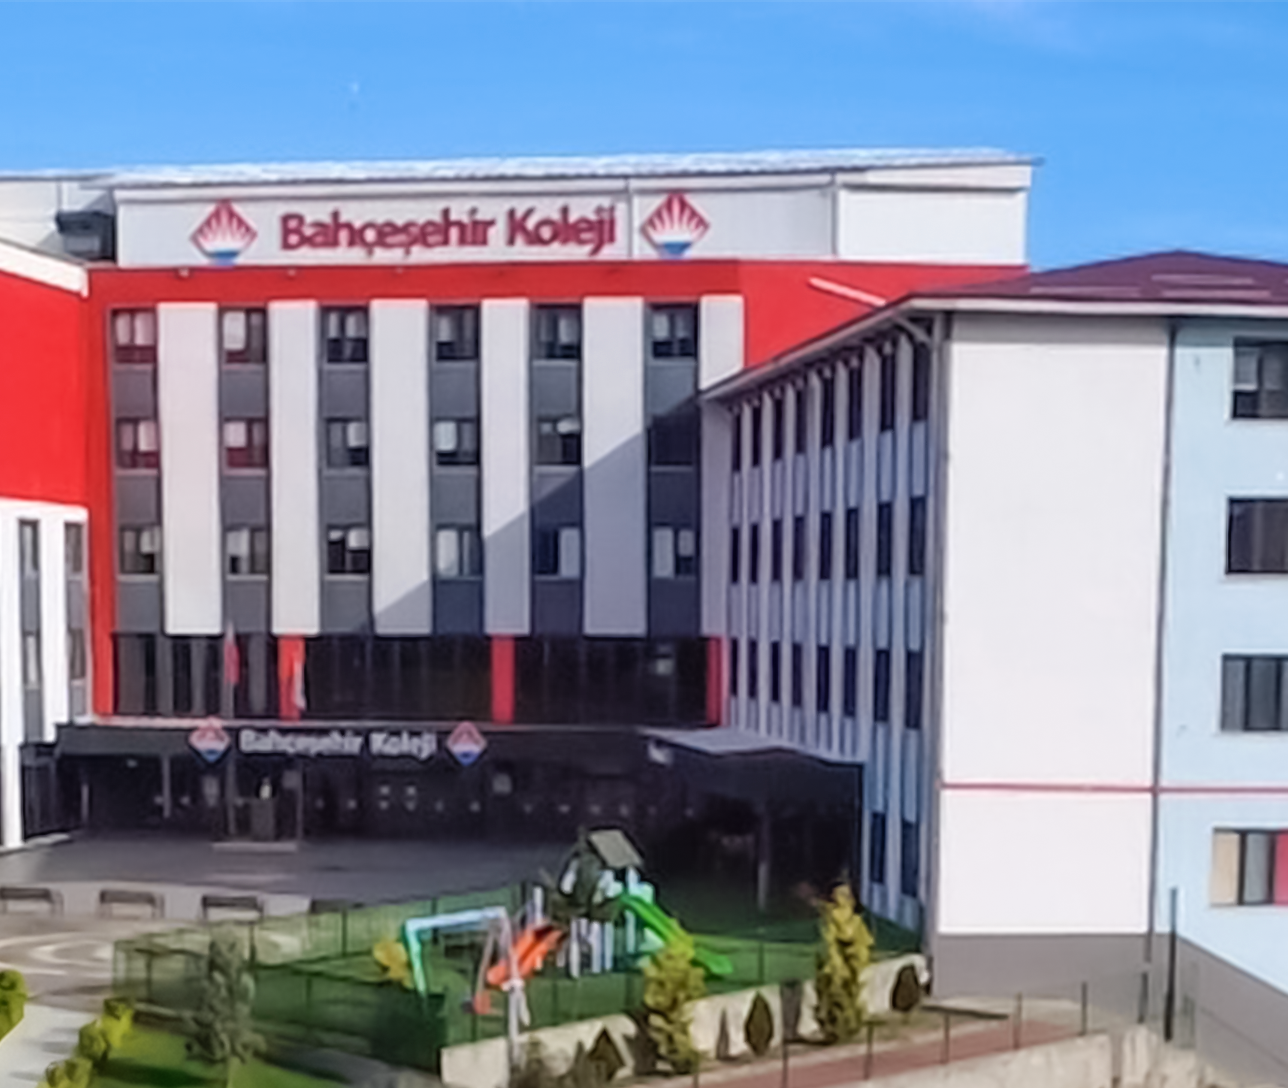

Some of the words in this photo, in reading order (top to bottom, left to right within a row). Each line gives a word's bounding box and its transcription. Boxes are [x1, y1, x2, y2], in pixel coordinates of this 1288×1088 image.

[281, 207, 495, 258] Bahçeşehir
[507, 204, 615, 256] Koleji
[369, 730, 437, 759] Koleji
